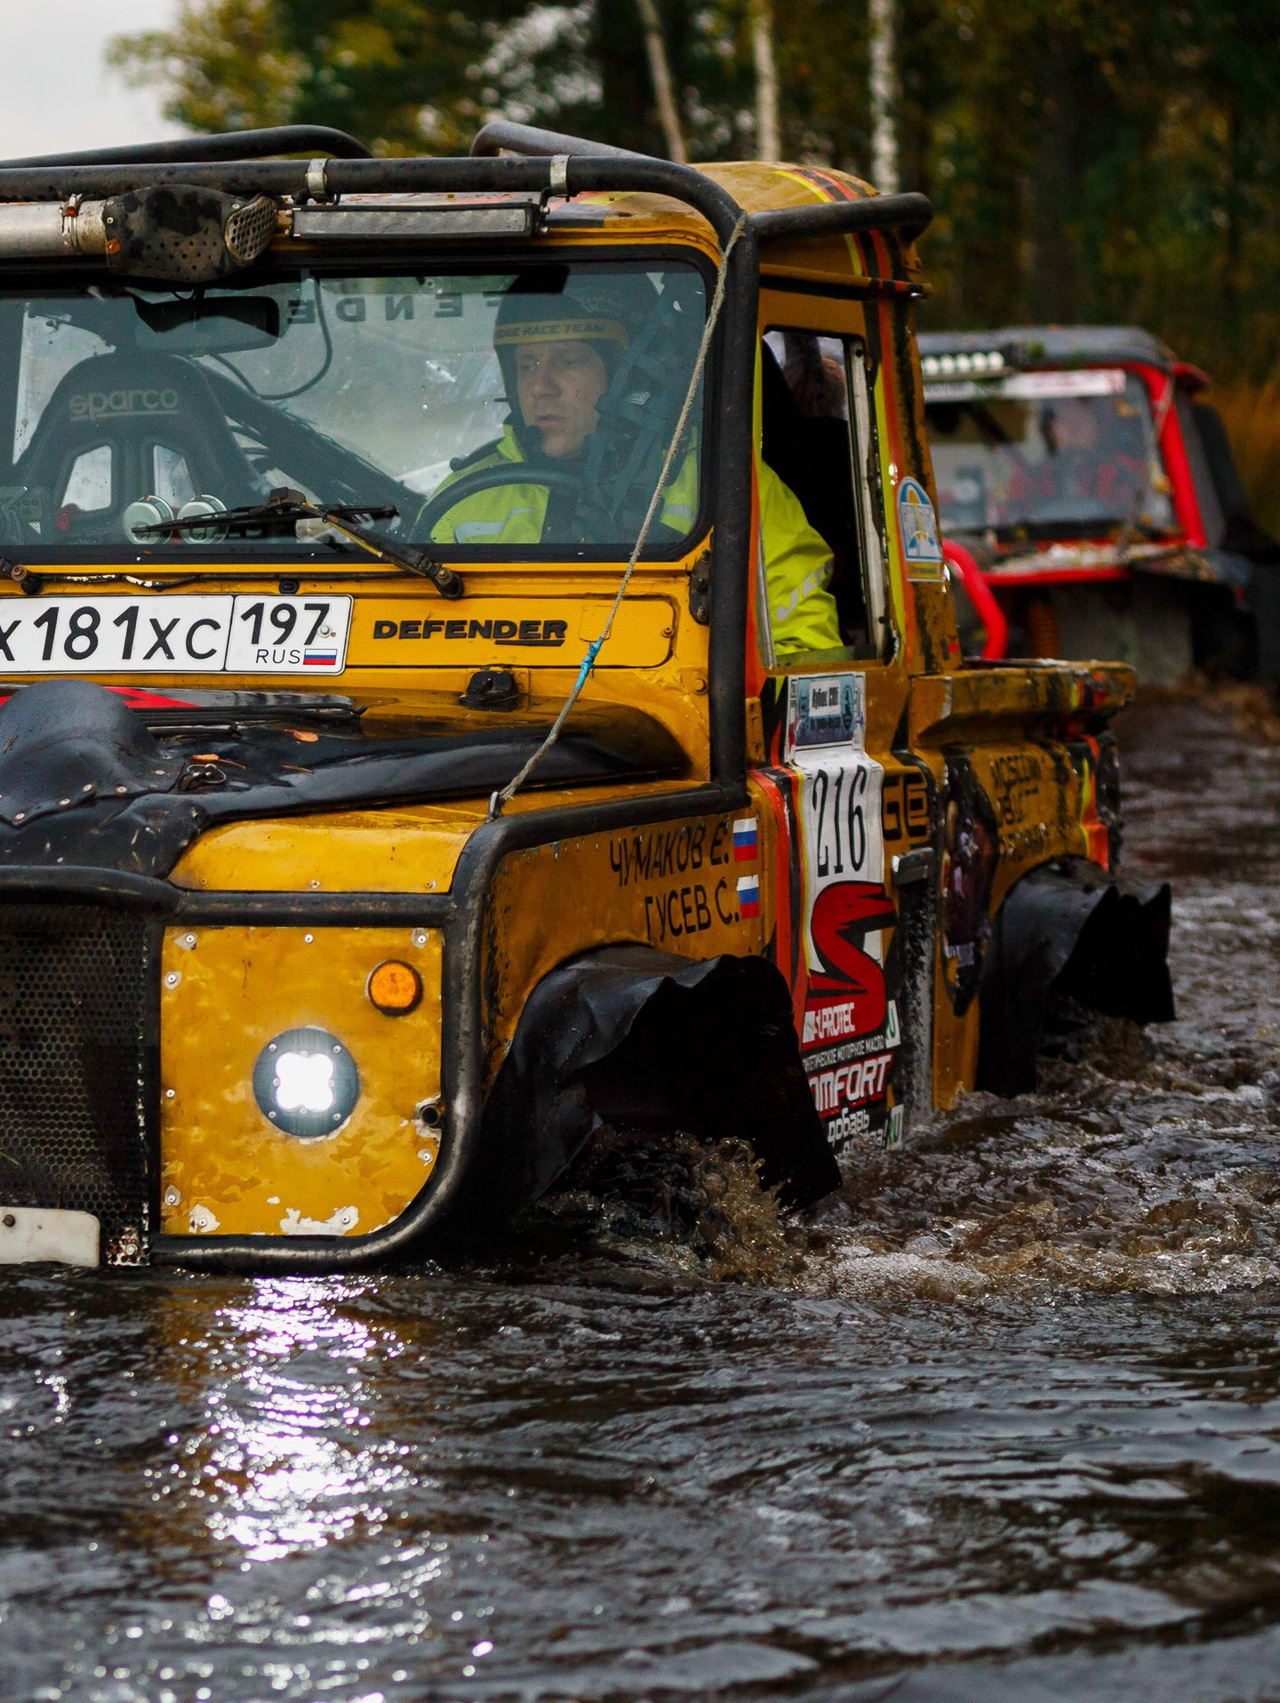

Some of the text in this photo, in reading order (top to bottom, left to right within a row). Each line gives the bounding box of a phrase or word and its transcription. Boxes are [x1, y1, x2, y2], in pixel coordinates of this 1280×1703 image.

[70, 388, 179, 421] sparco
[241, 603, 331, 646] 197
[373, 620, 568, 640] DEFENDER
[256, 649, 301, 664] RUS
[812, 764, 867, 878] 216
[610, 824, 707, 887] ЧУМАКОВ
[644, 884, 711, 942] ГУСЕВ
[808, 1055, 892, 1112] OMFORT
